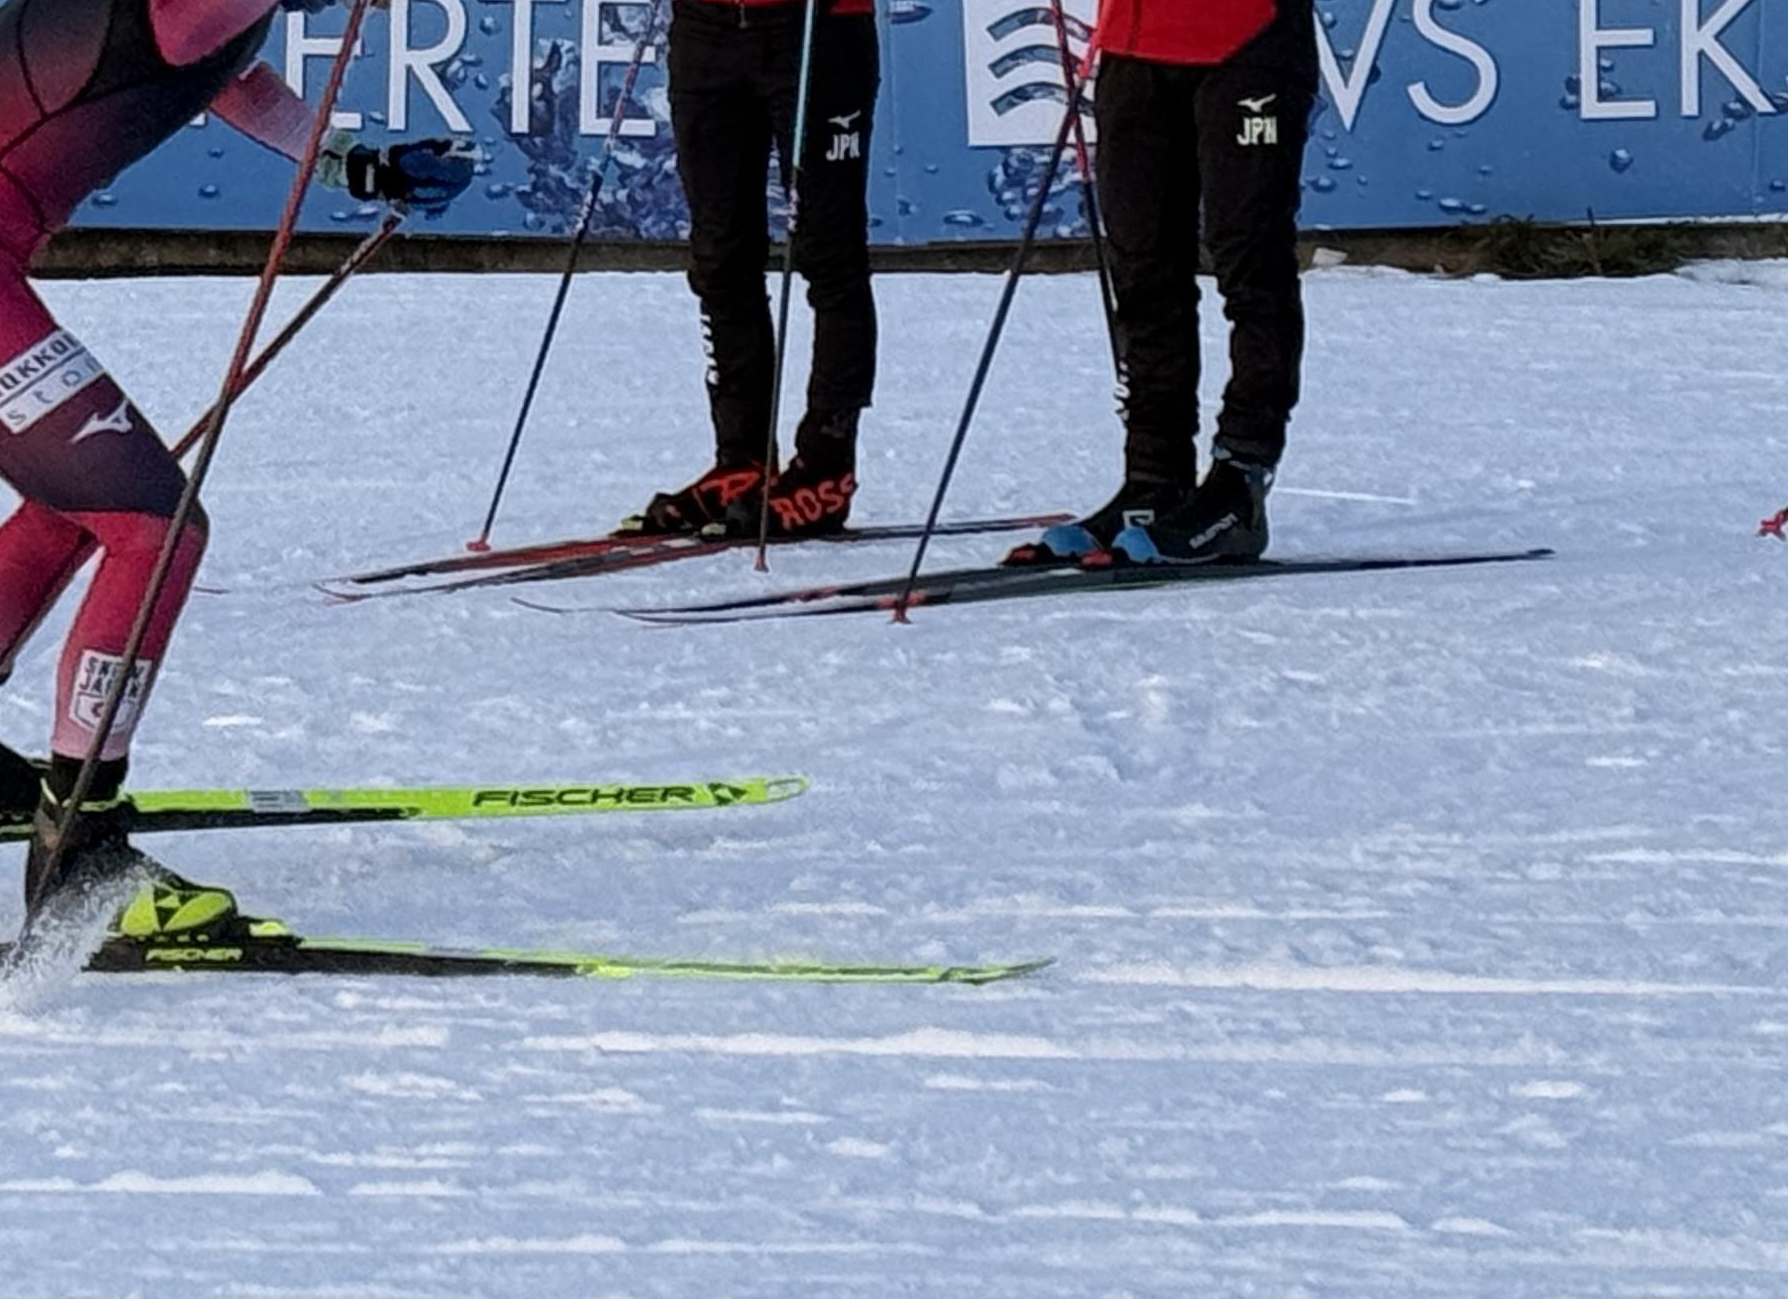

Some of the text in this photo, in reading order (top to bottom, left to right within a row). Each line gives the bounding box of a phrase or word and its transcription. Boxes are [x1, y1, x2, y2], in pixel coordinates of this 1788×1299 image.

[1236, 116, 1278, 146] JPN
[826, 132, 860, 162] JPN
[472, 785, 697, 807] FISCHER
